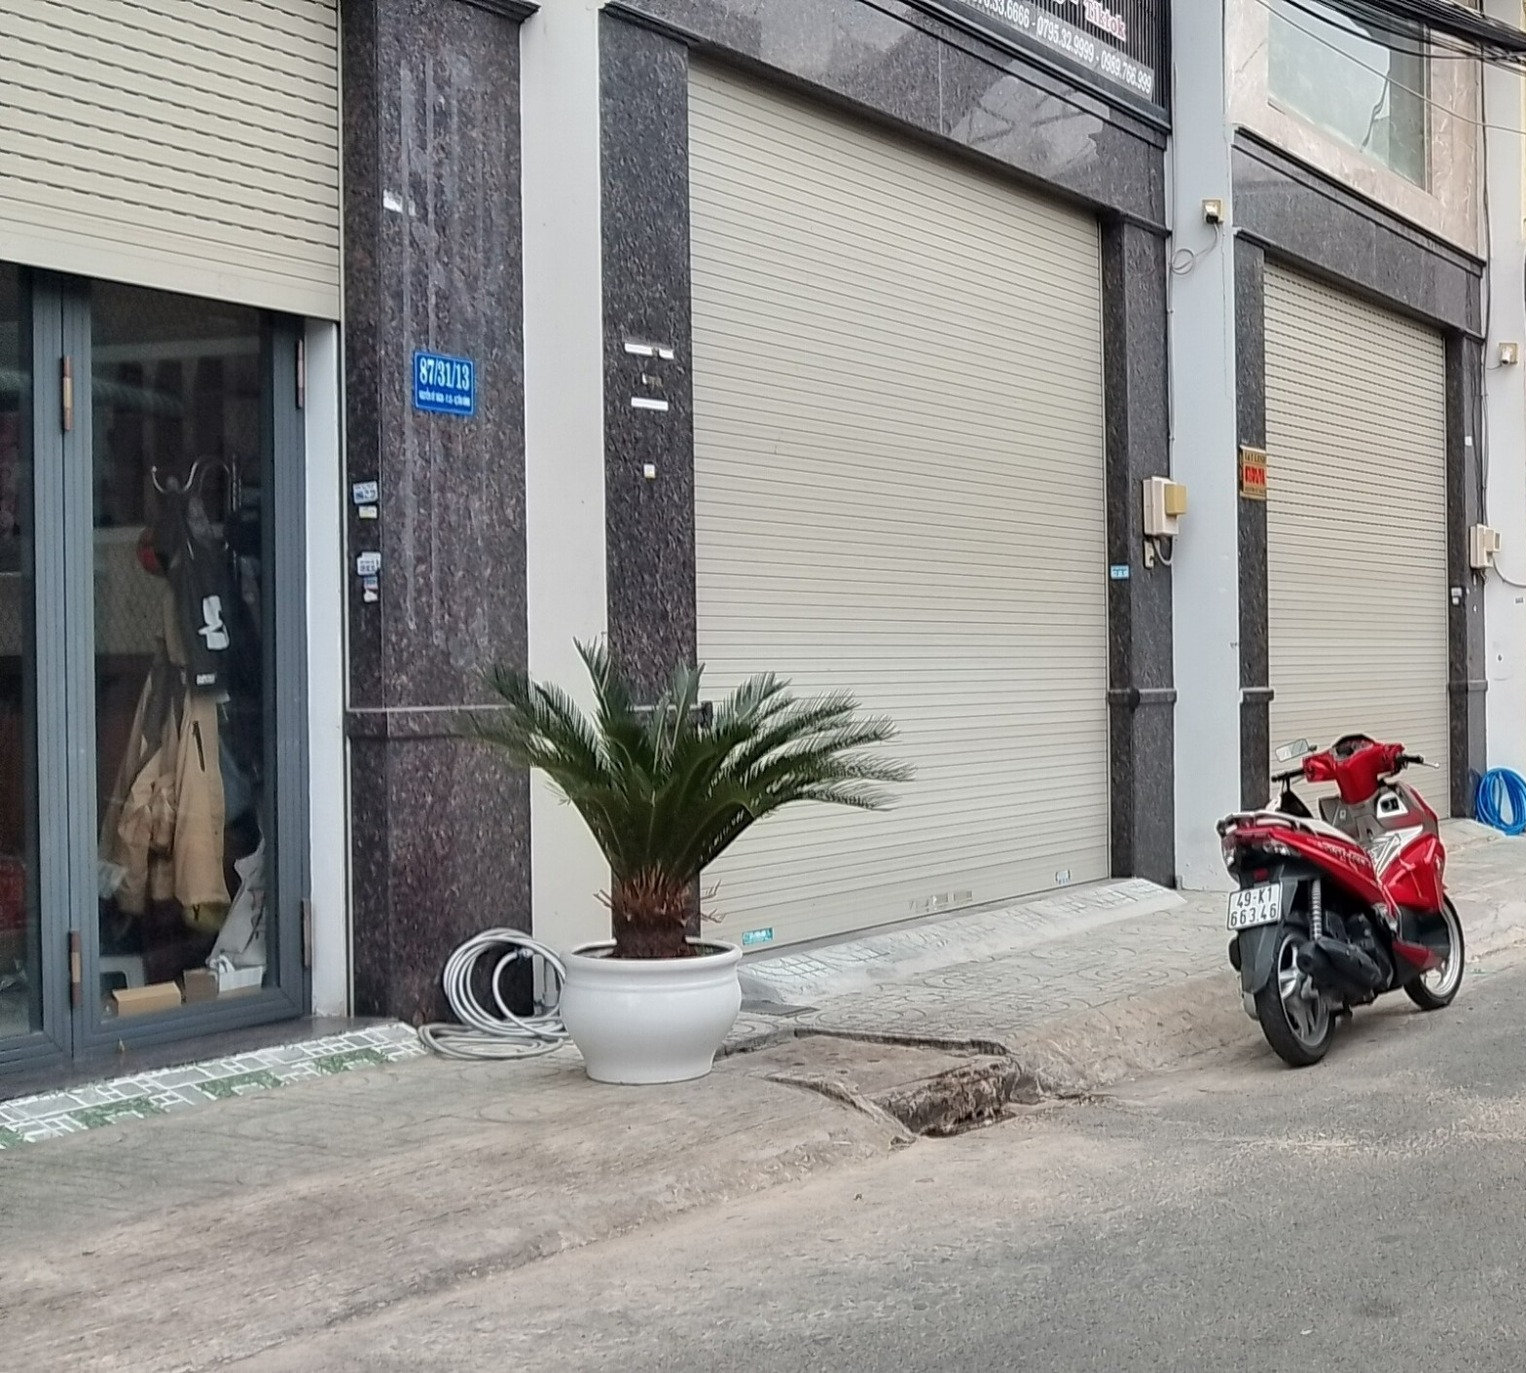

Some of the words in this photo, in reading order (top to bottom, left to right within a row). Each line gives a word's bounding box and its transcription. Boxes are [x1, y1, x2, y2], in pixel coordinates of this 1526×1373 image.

[1084, 0, 1127, 42] Tiktok
[1036, 15, 1095, 64] 0795.32.9999
[419, 357, 471, 391] 87/31/13
[1237, 887, 1272, 908] 49-K1
[1230, 903, 1277, 927] 663.46
